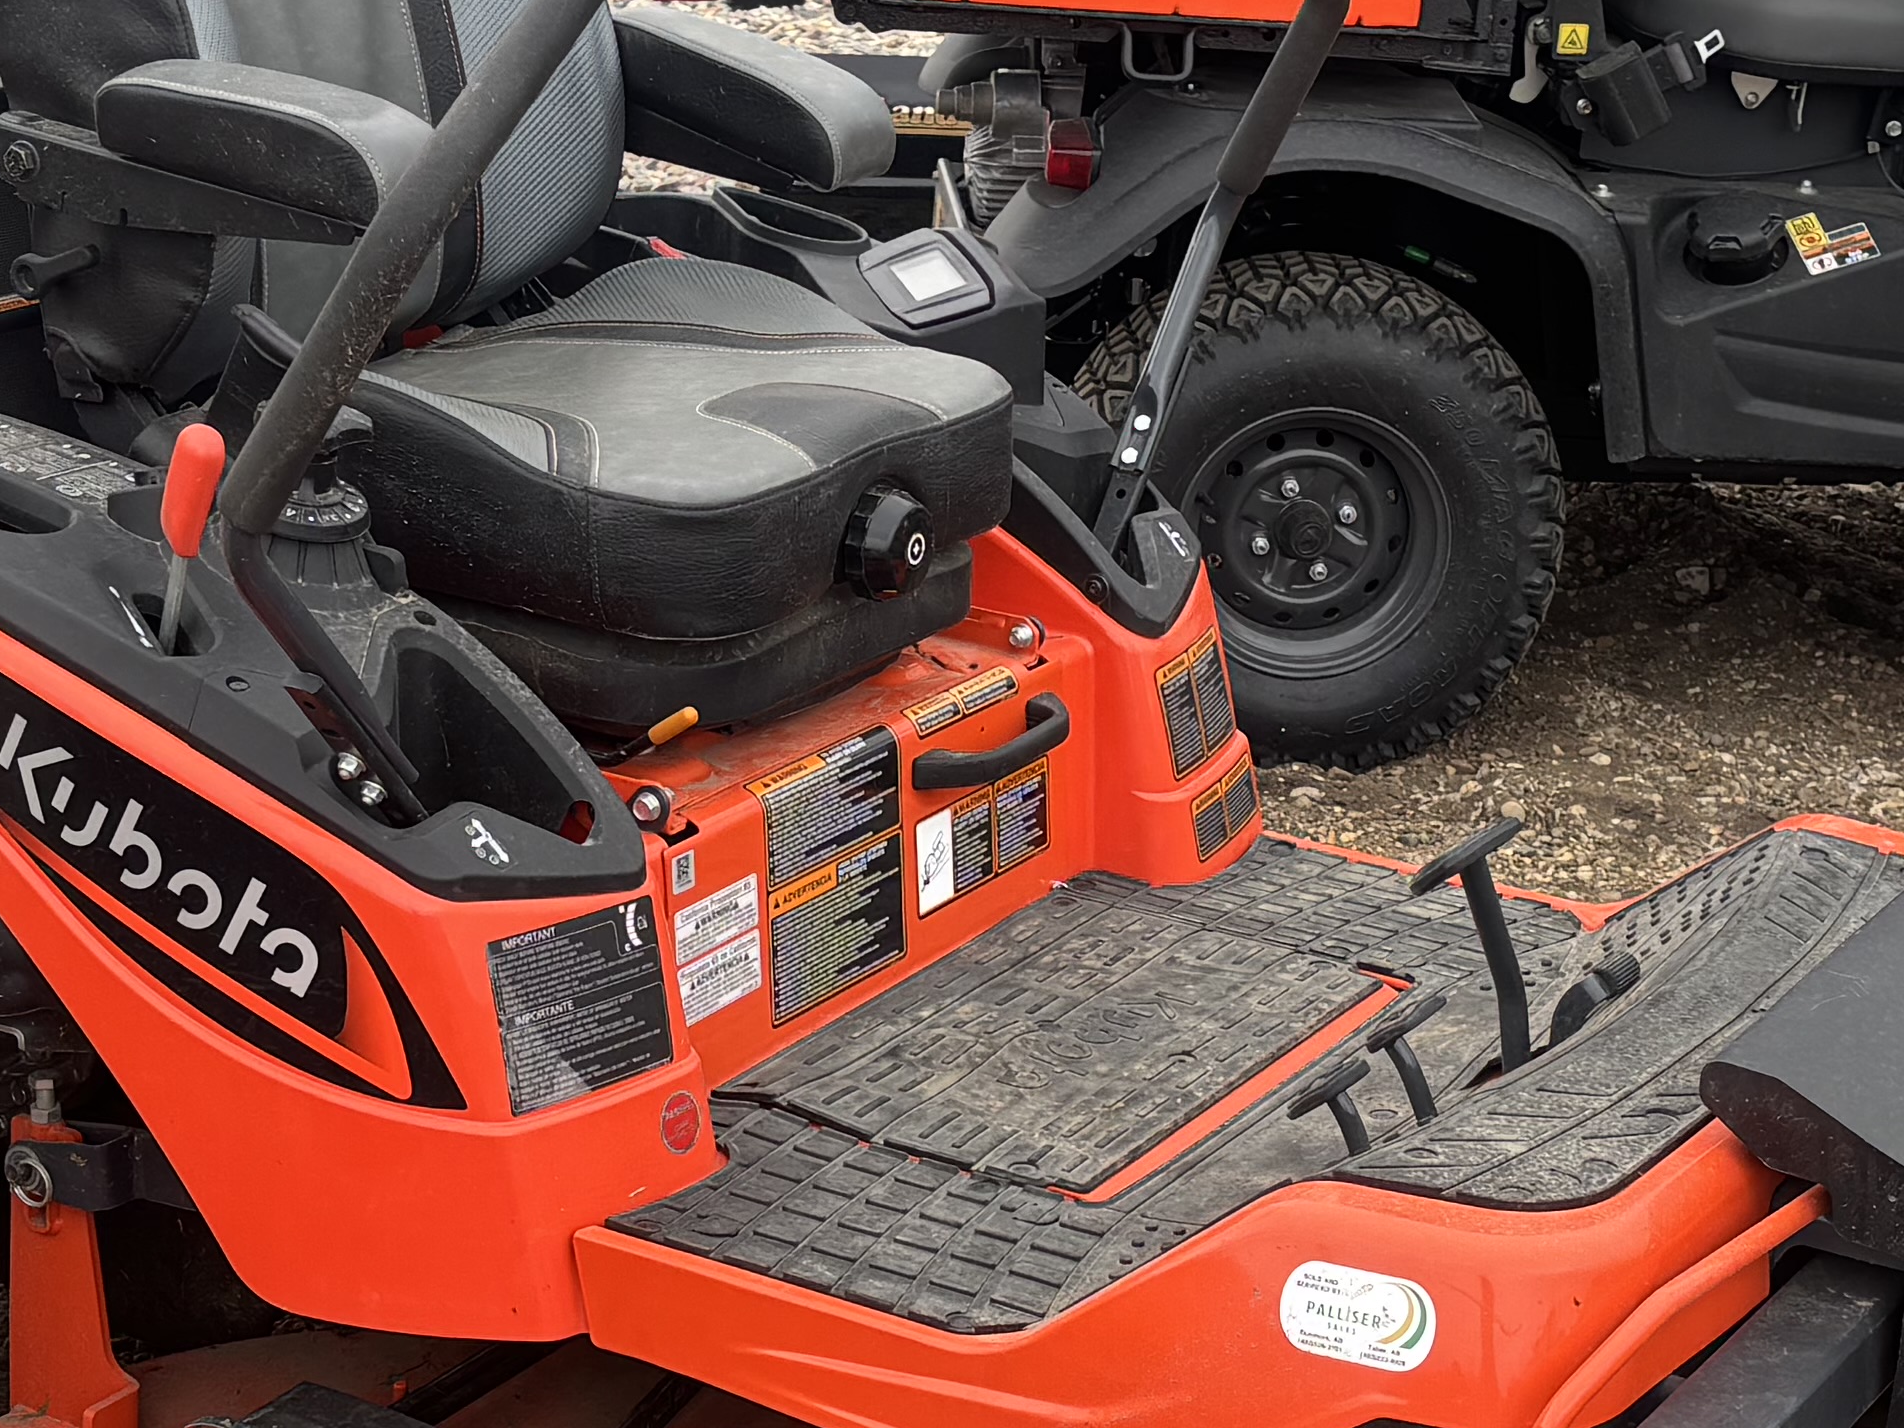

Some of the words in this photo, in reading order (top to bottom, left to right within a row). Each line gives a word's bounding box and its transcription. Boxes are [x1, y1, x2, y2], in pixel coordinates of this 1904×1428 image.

[501, 926, 557, 952] IMPORTANT
[513, 999, 576, 1027] IMPORTANTE
[1305, 1300, 1382, 1330] PALLISER
